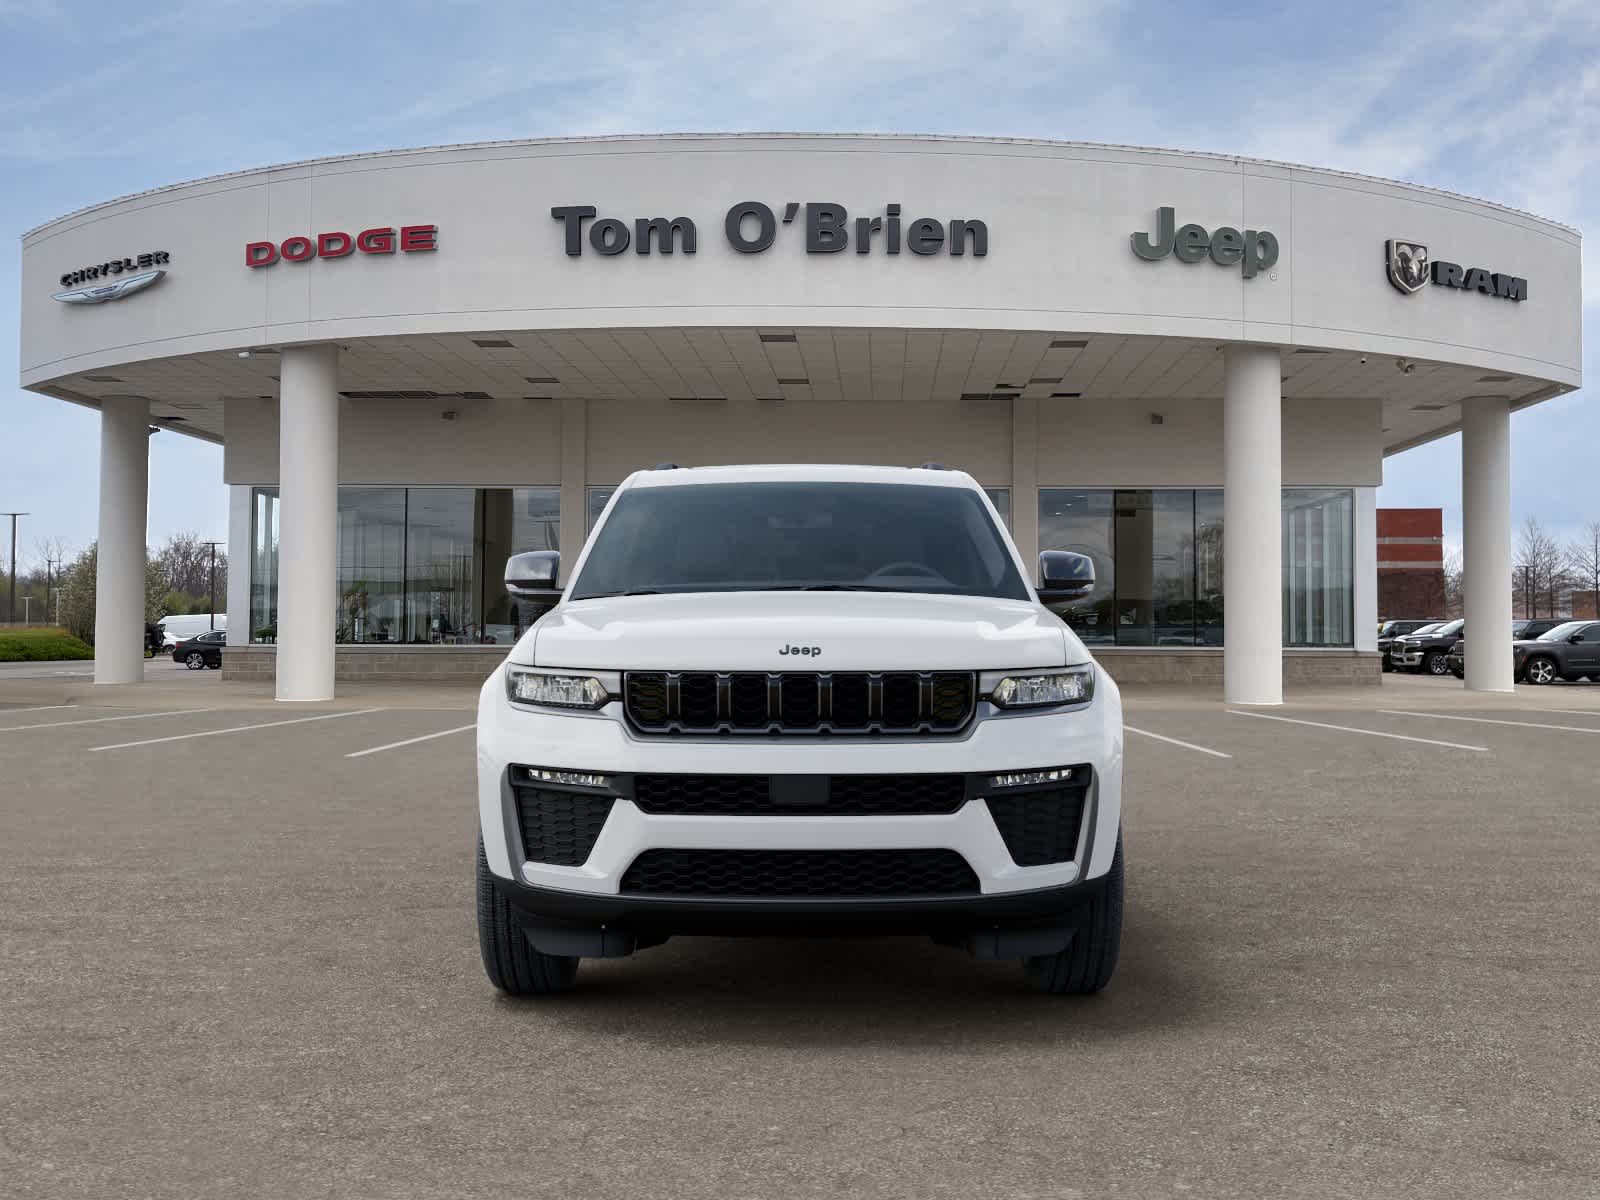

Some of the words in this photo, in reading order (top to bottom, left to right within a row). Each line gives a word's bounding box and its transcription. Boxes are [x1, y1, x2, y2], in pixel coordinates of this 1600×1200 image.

[245, 224, 438, 269] DODGE
[551, 204, 697, 256] Tom
[724, 200, 988, 256] O'Brien
[1130, 206, 1279, 279] Jeep
[60, 250, 170, 287] CHRYSLER
[1431, 260, 1528, 302] RAM
[778, 644, 822, 658] Jeep
